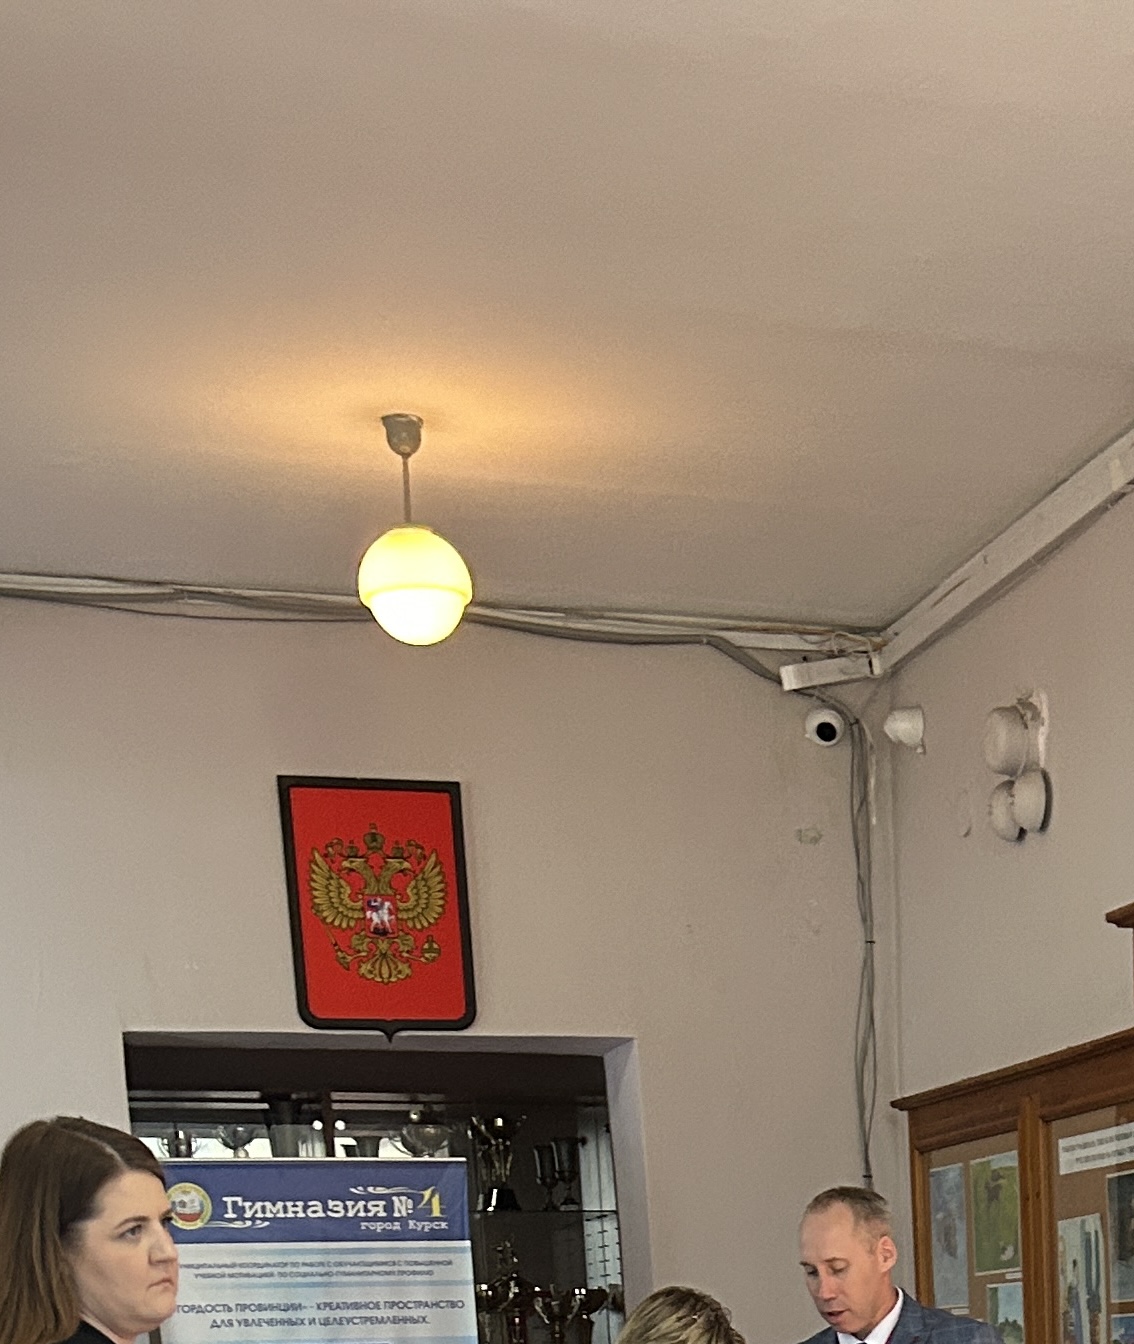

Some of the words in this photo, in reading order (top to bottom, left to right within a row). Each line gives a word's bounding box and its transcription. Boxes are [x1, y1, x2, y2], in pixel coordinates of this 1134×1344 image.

[222, 1196, 387, 1219] Гимназия
[391, 1195, 414, 1218] №
[417, 1186, 447, 1218] 4
[360, 1221, 402, 1232] город
[408, 1219, 449, 1230] Курск
[316, 1301, 382, 1311] КРЕАТИВНОЕ
[384, 1300, 465, 1310] ПРОСТРАНСТВО
[210, 1319, 234, 1329] ДЛЯ
[236, 1317, 306, 1327] УВЛЕЧЕННЫХ
[308, 1317, 316, 1326] И
